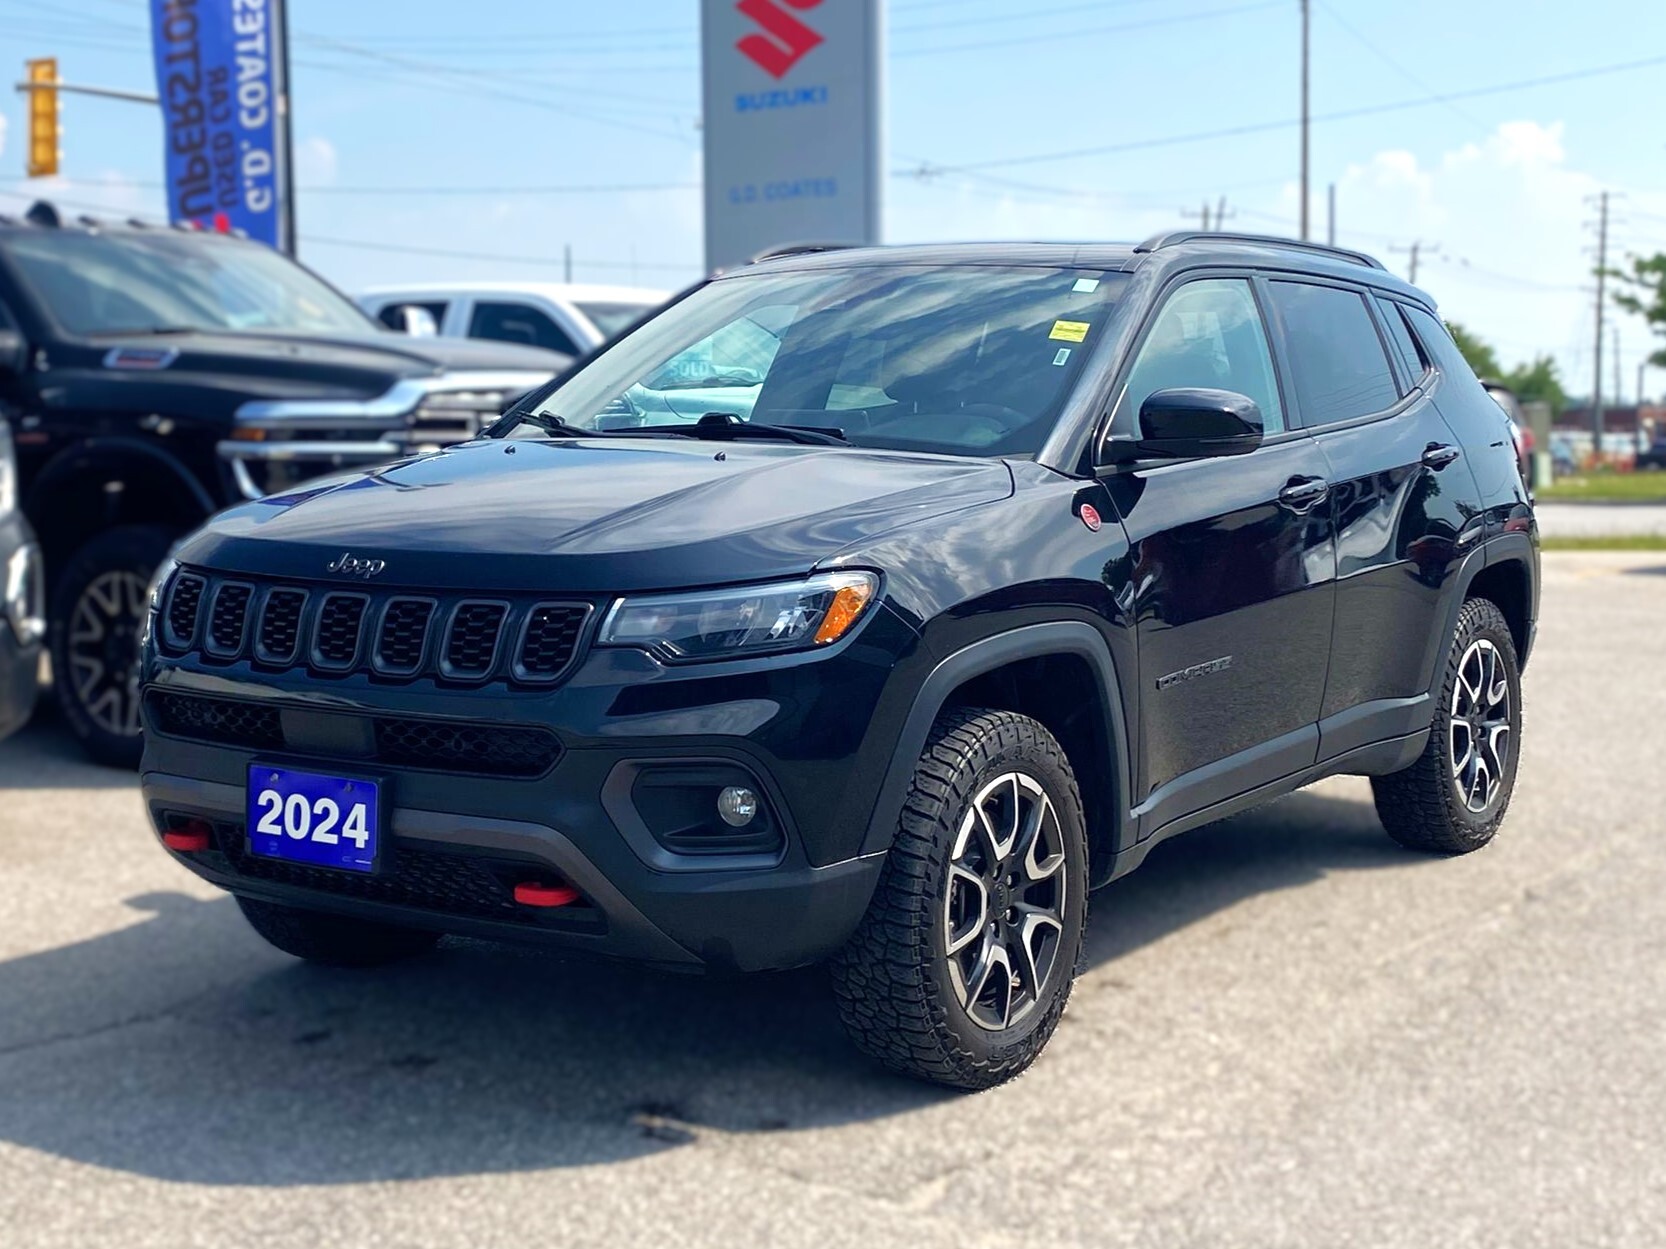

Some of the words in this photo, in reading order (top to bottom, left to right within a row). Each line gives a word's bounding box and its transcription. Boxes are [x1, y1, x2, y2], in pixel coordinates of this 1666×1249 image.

[735, 85, 828, 112] SUZUKI
[327, 552, 385, 579] Jeep
[257, 789, 369, 849] 2024
